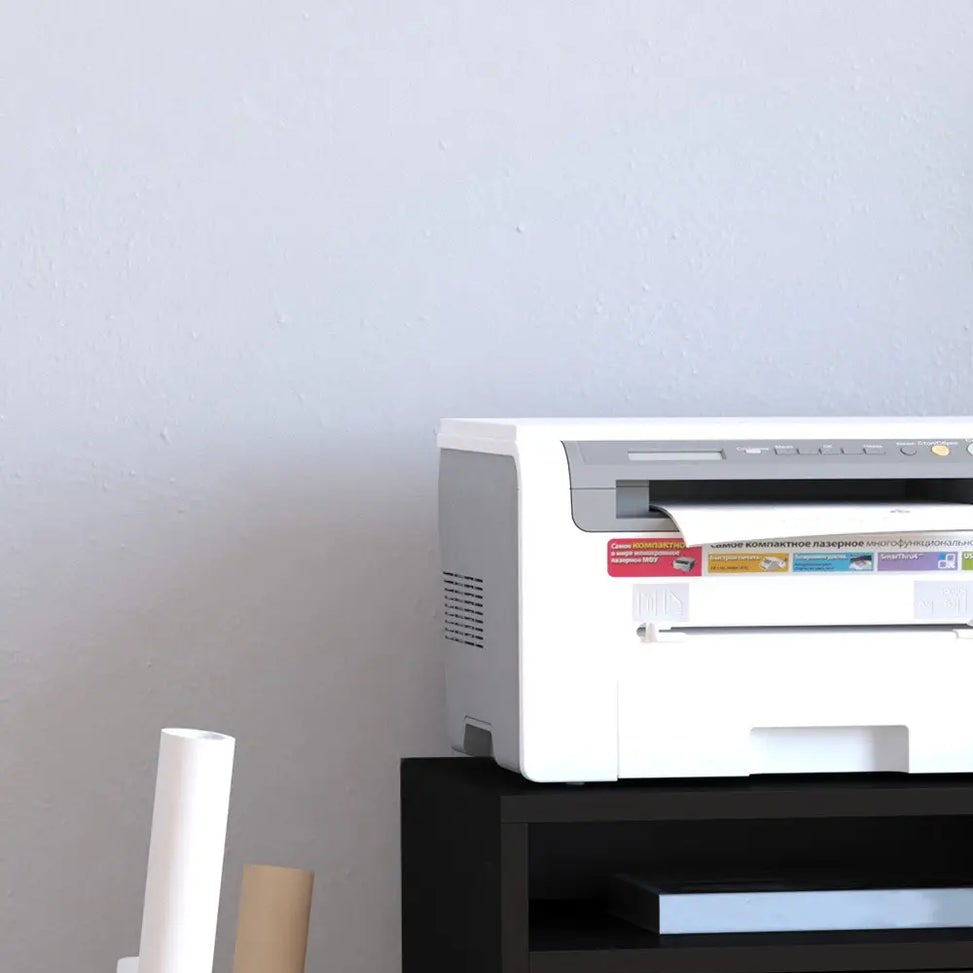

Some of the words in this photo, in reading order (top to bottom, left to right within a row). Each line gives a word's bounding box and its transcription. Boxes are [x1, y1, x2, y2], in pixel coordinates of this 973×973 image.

[632, 541, 686, 549] КОМПАКТНО
[745, 541, 811, 549] компактное
[812, 540, 864, 549] лазерное
